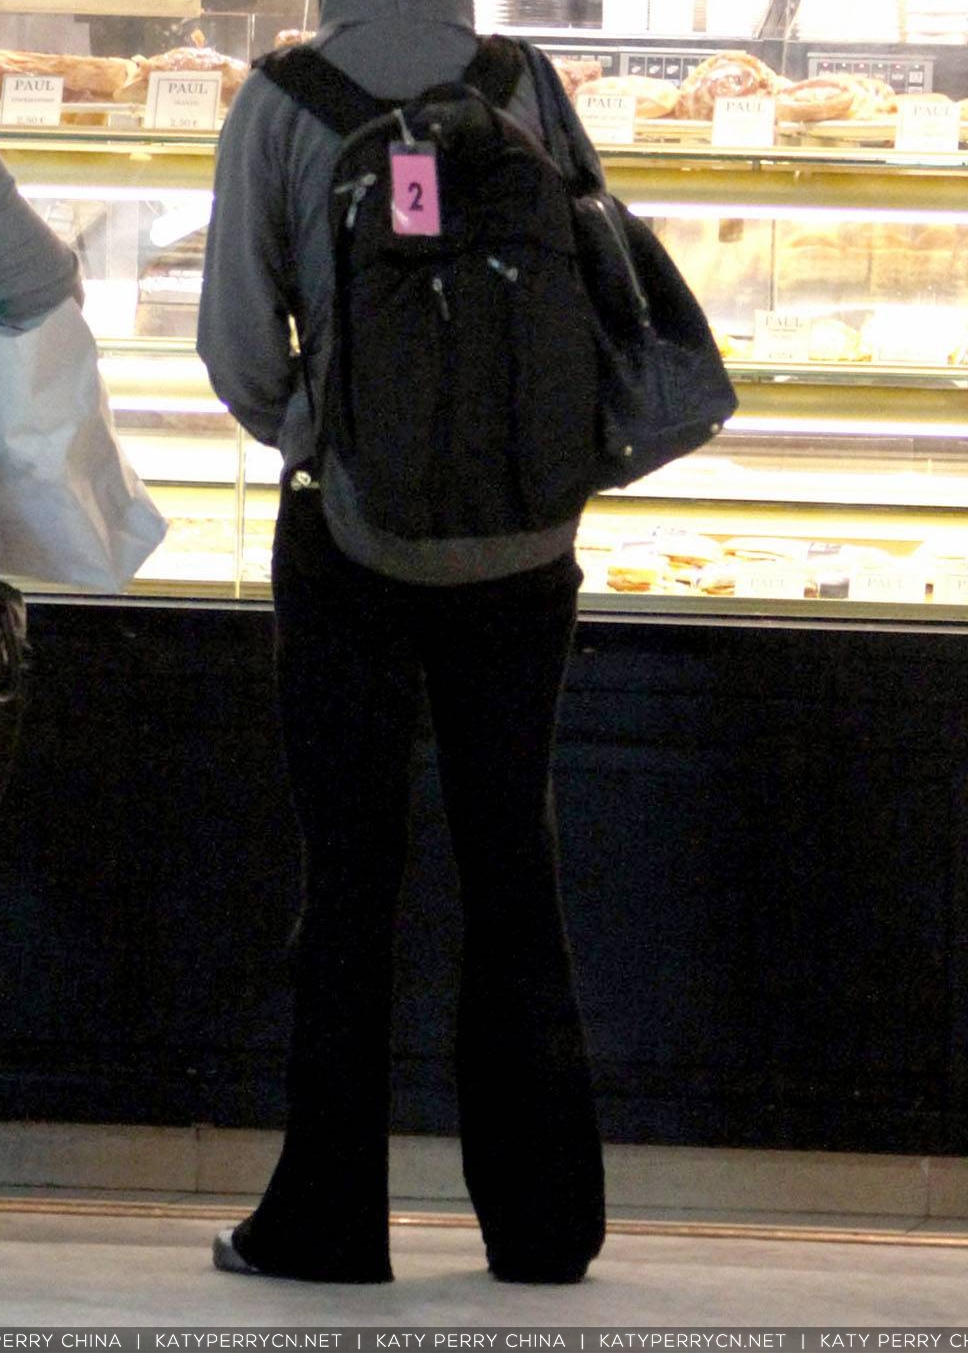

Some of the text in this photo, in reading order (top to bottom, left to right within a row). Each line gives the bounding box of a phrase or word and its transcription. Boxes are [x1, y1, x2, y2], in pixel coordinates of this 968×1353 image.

[14, 79, 55, 91] PAUL
[168, 82, 208, 94] PAUL
[587, 97, 626, 109] PAUL
[726, 101, 764, 112] PAUL
[407, 182, 424, 212] 2
